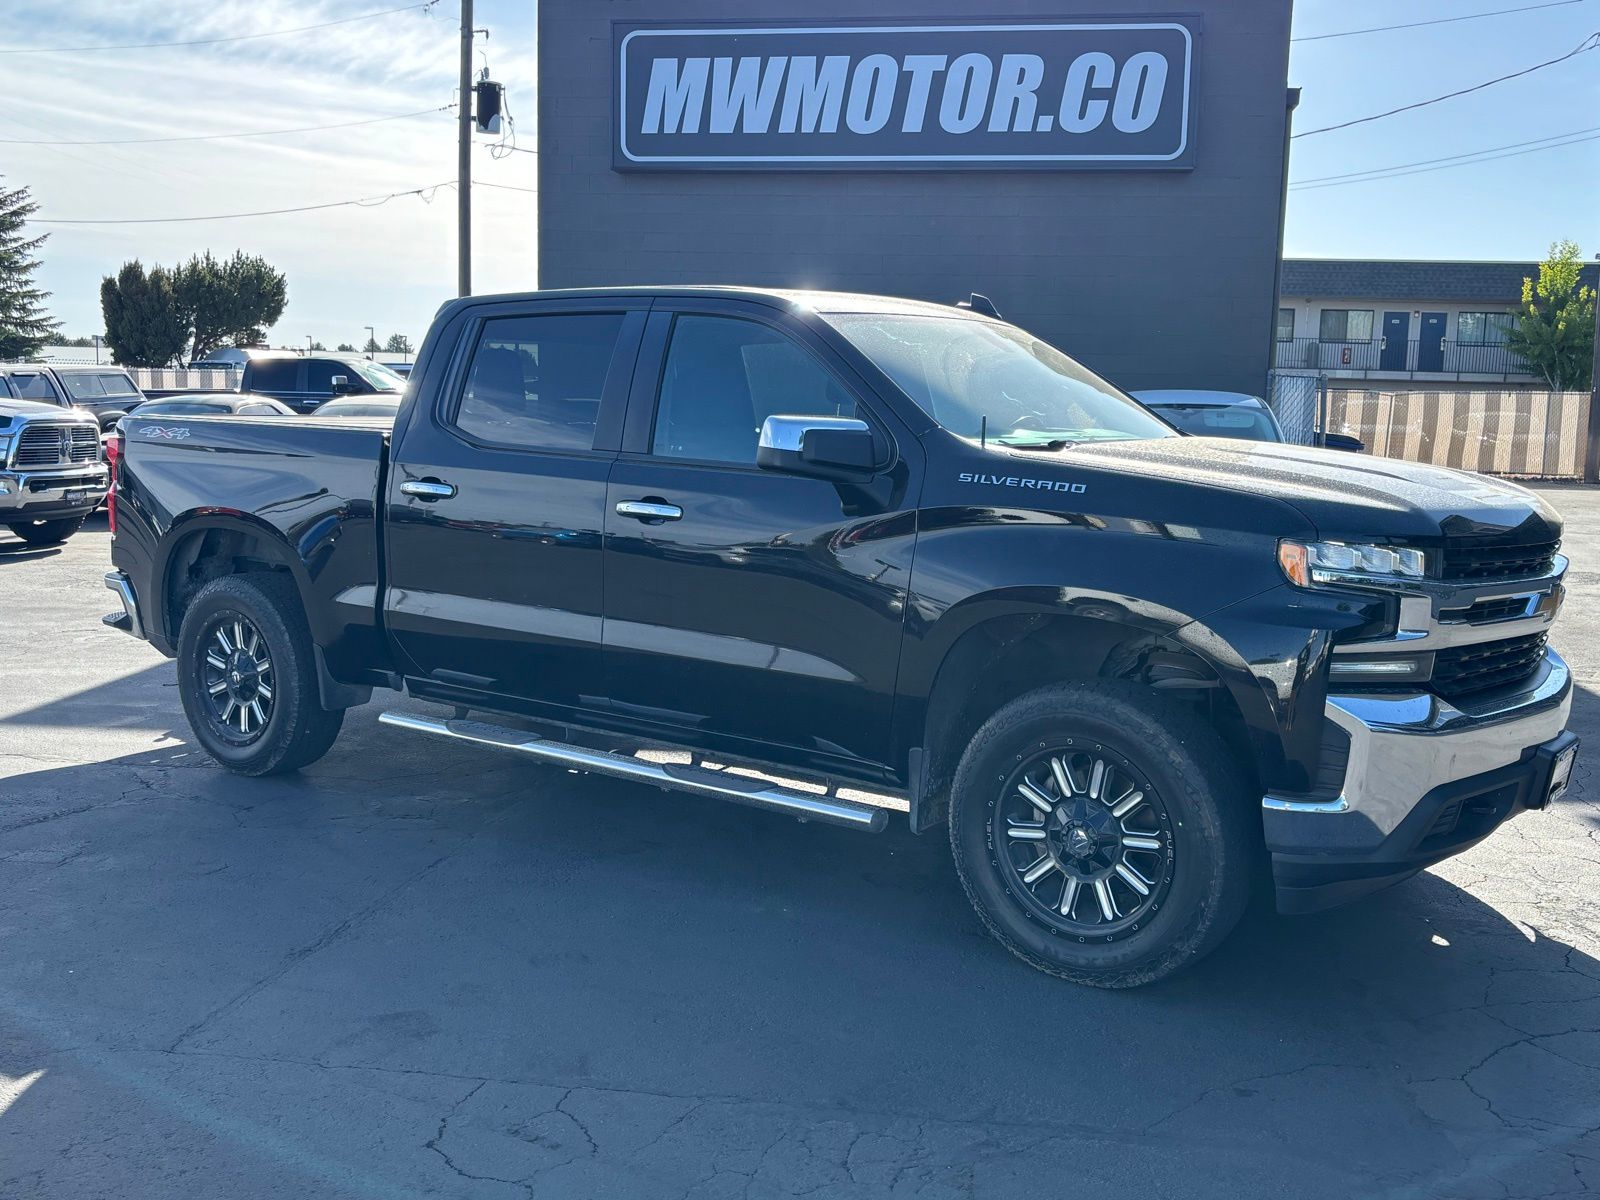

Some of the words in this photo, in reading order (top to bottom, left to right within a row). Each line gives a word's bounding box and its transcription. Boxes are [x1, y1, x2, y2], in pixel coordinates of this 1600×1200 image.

[641, 51, 1168, 135] MWMOTOR.CO
[958, 472, 1087, 494] SILVERADO
[1165, 830, 1173, 866] FUEL
